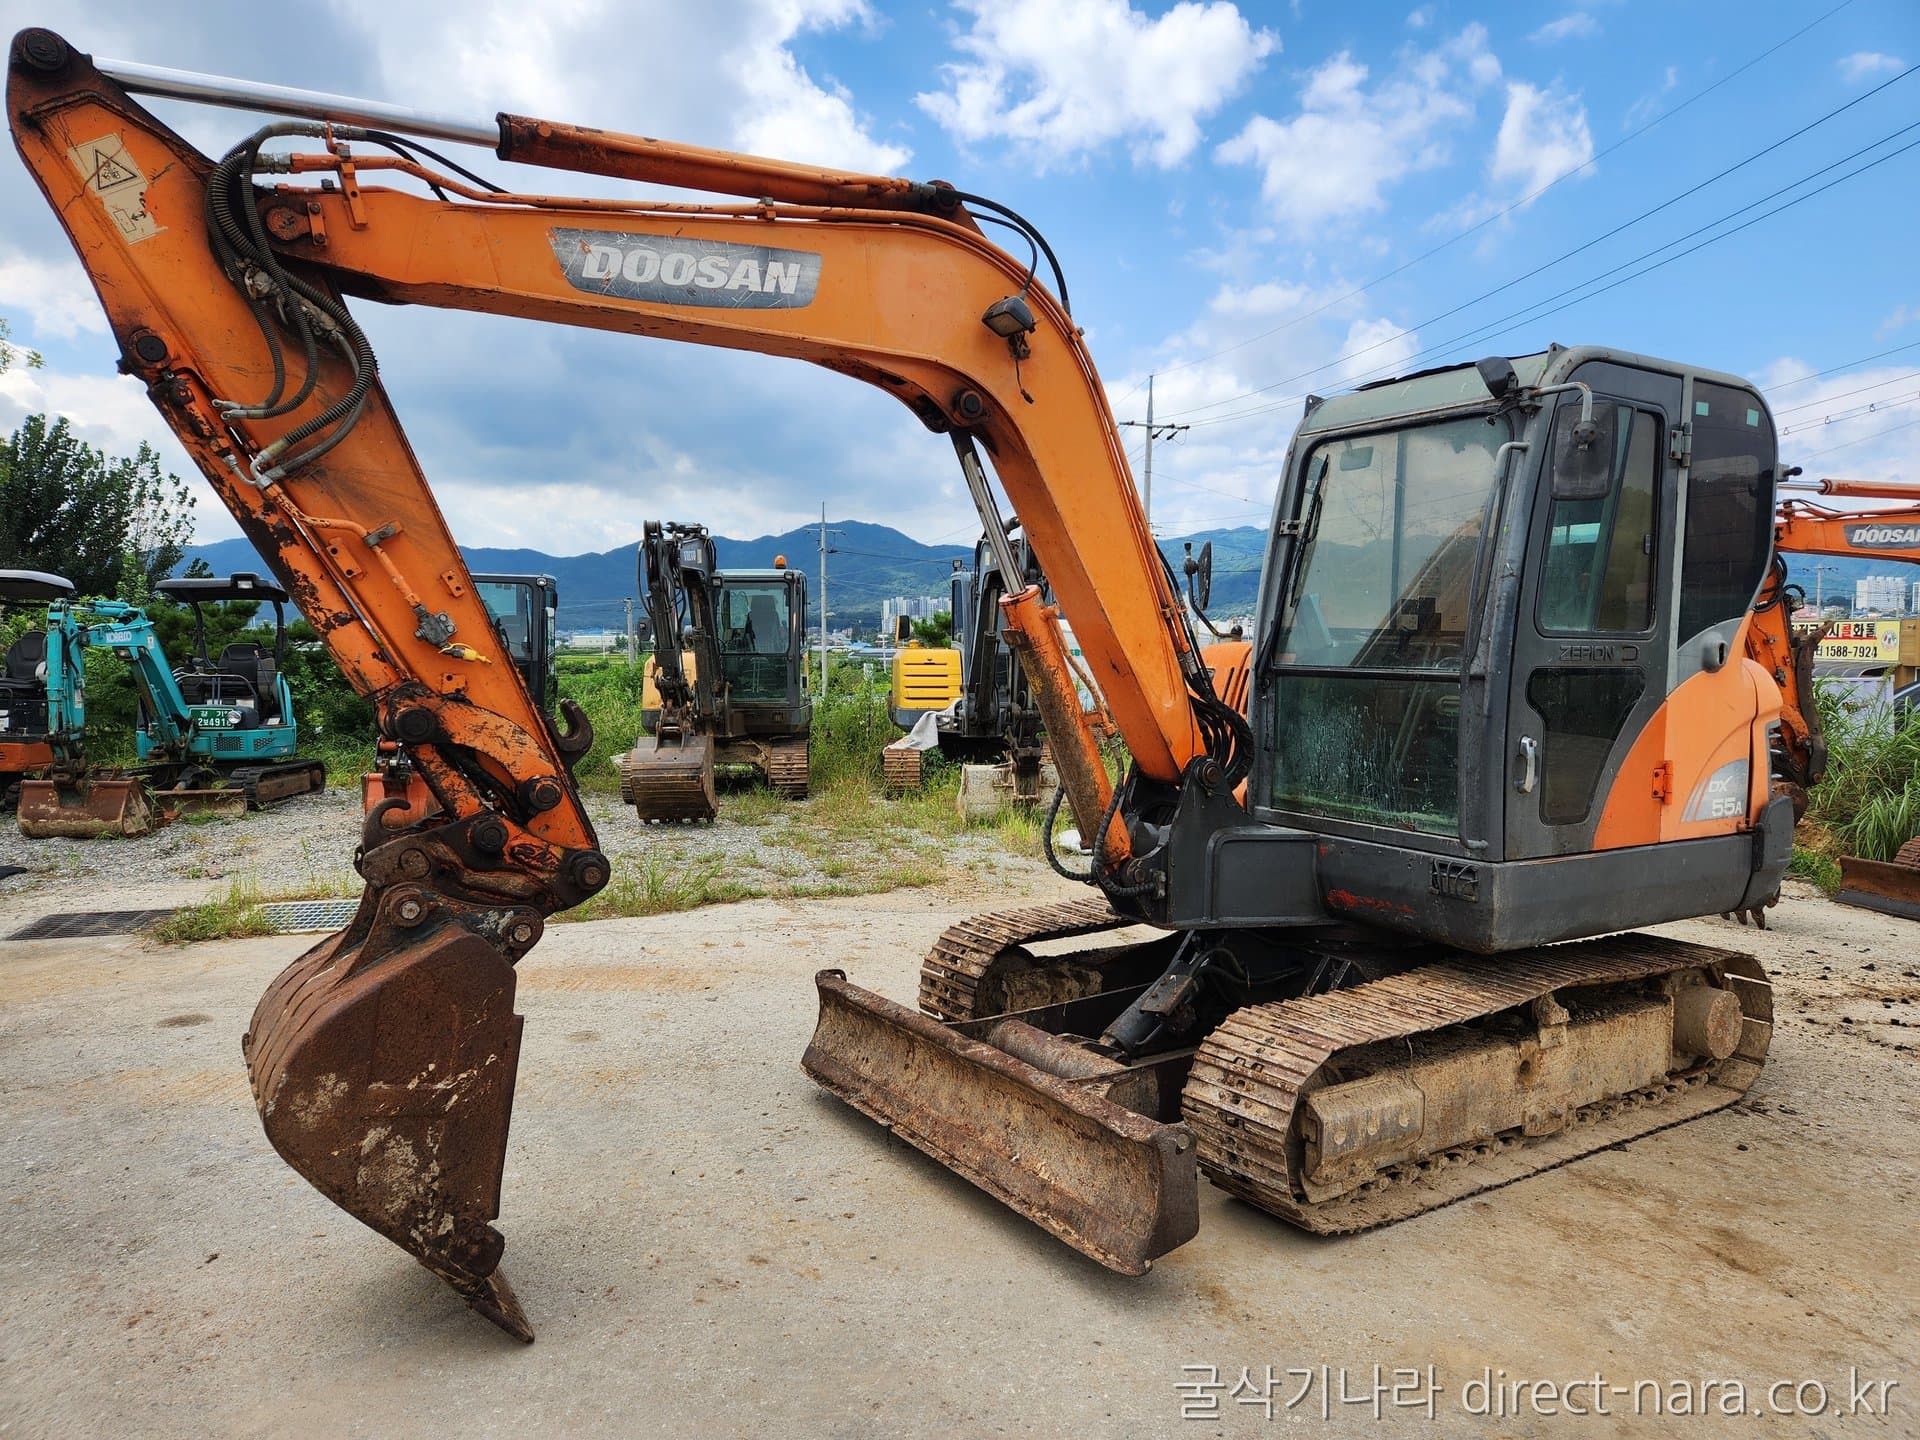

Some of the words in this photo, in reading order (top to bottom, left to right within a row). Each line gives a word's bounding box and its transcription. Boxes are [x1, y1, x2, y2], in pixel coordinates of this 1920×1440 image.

[581, 245, 801, 295] DOOSAN
[1825, 645, 1878, 658] 1588-7924
[1708, 775, 1733, 793] DX
[1711, 797, 1743, 817] 55A
